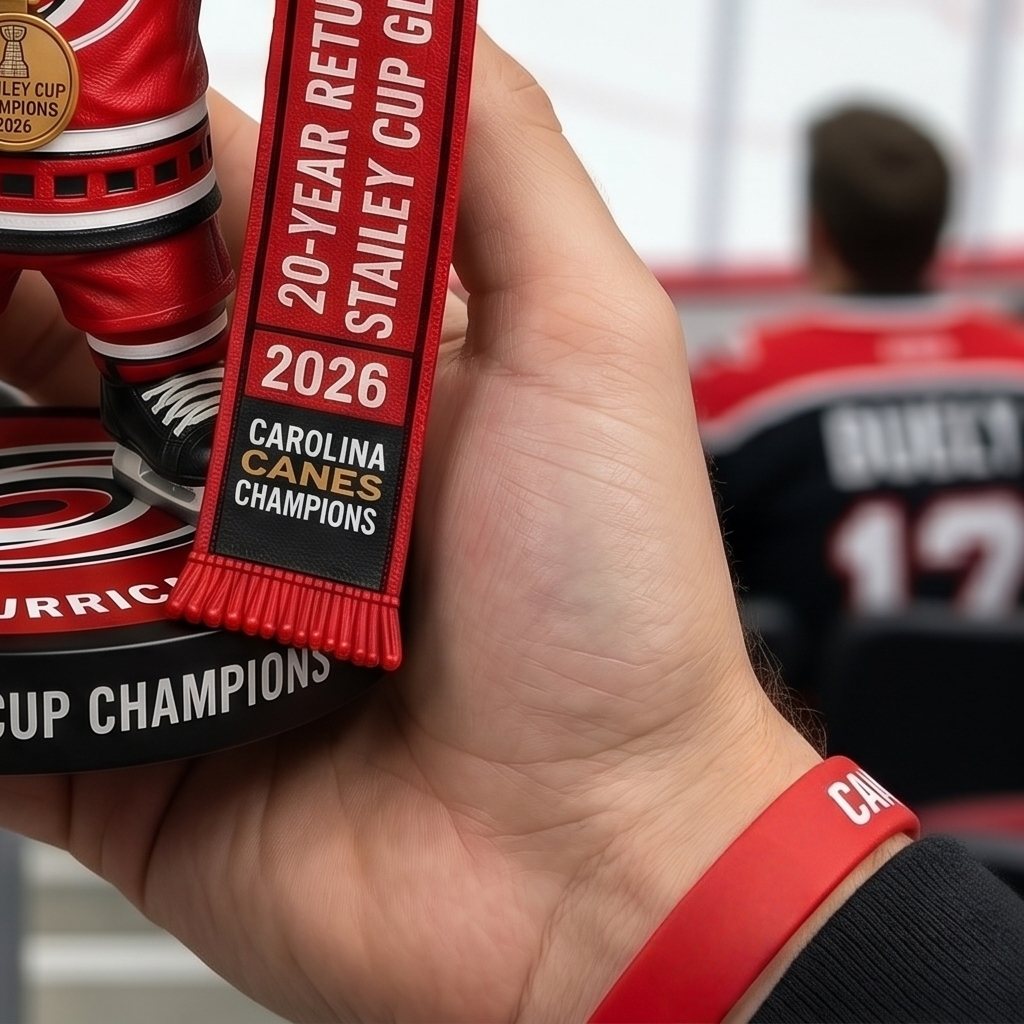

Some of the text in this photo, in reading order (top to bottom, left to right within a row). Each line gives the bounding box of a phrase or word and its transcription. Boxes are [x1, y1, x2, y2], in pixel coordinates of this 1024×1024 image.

[35, 82, 66, 98] CUP
[372, 57, 426, 149] CUP
[277, 123, 350, 315] 20-YEAR
[344, 158, 415, 339] STAILEY
[261, 344, 389, 408] 2026
[241, 449, 383, 502] CANES
[249, 418, 386, 472] CAROLINA
[234, 479, 377, 536] CHAMPIONS
[89, 648, 331, 735] CHAMPIONS
